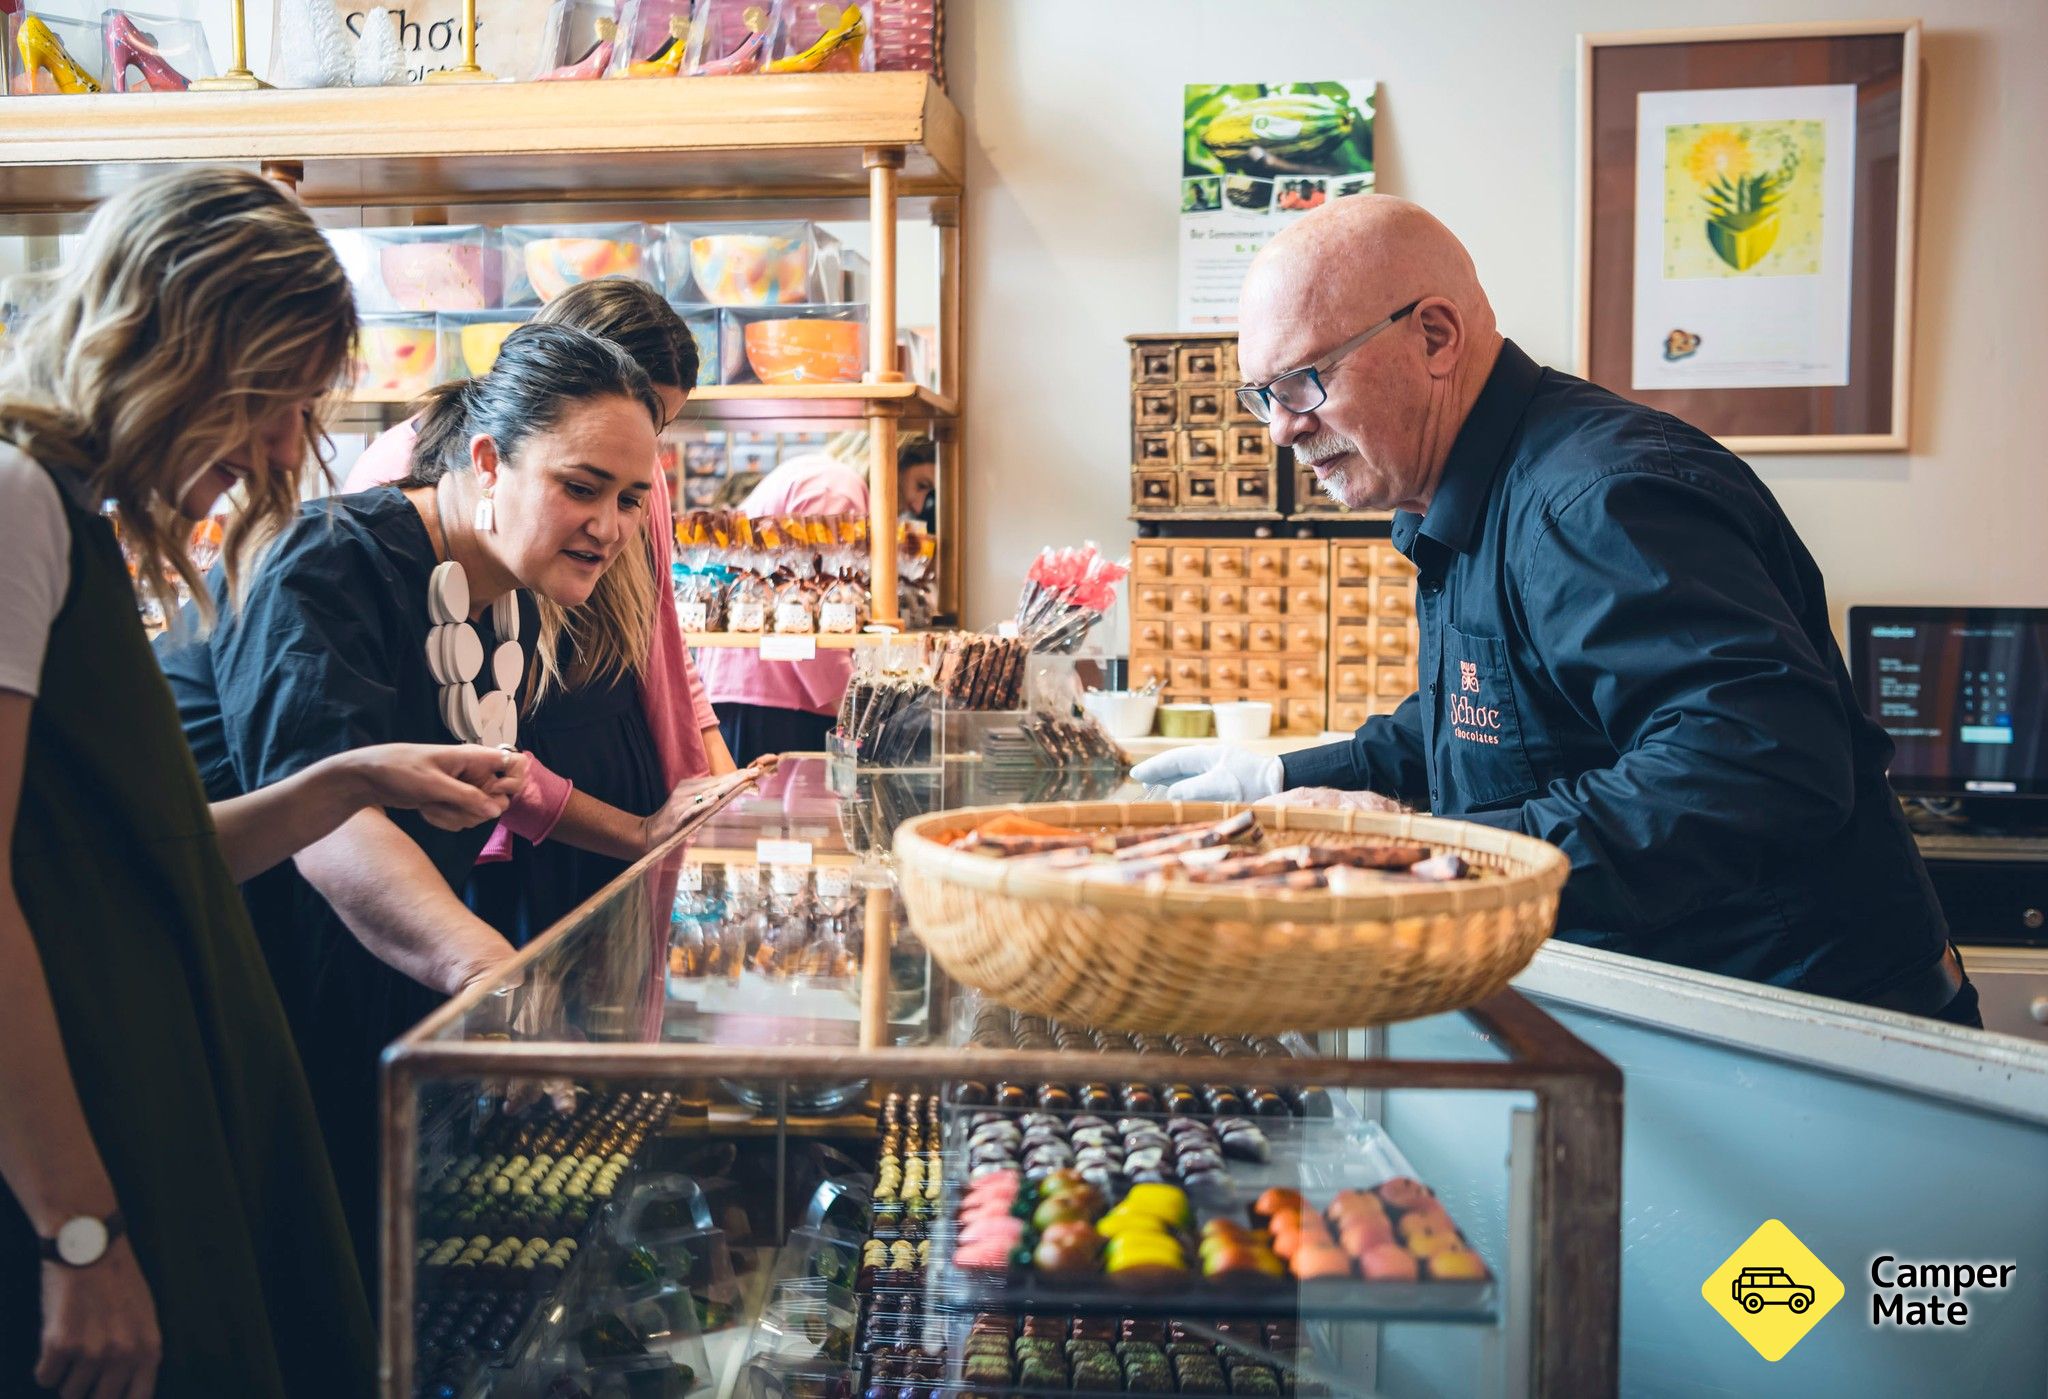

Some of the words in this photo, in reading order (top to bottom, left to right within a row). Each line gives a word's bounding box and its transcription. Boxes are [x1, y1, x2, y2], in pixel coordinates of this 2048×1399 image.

[345, 9, 483, 51] Sho
[1450, 693, 1501, 729] Schoc
[1454, 726, 1499, 744] chocolates
